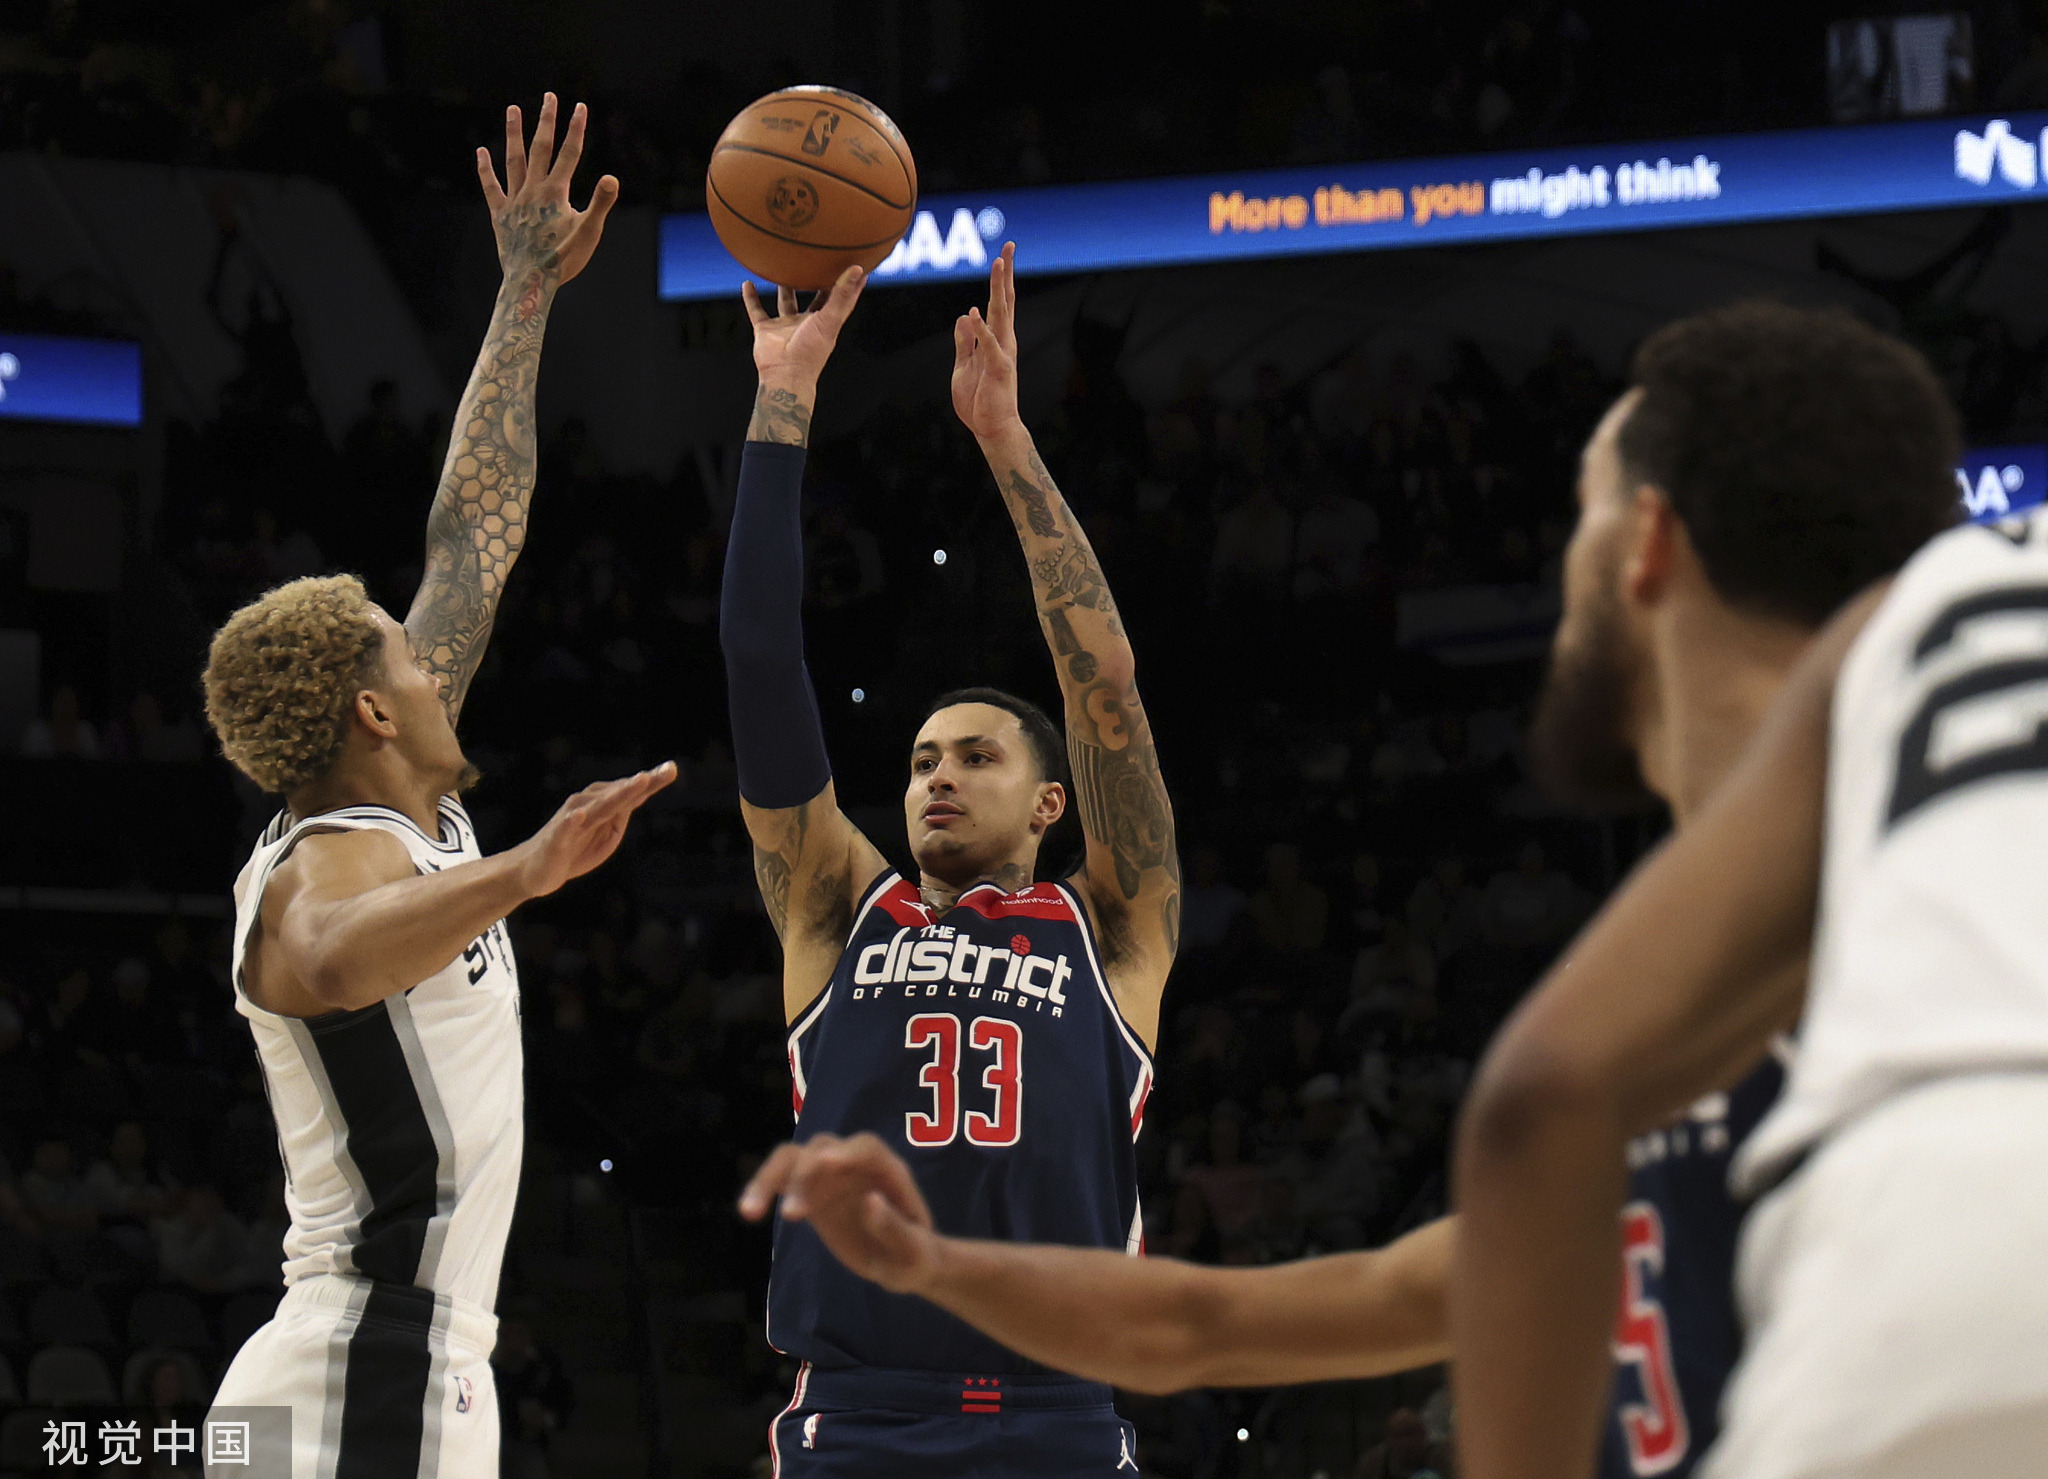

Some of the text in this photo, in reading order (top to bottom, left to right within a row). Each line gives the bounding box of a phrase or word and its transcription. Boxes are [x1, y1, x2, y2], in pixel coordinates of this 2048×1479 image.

[1208, 154, 1721, 236] More than you might think
[853, 926, 1073, 1006] district
[920, 924, 956, 940] THE
[852, 983, 1064, 1019] OF COLUMBIA
[904, 1012, 1024, 1148] 33
